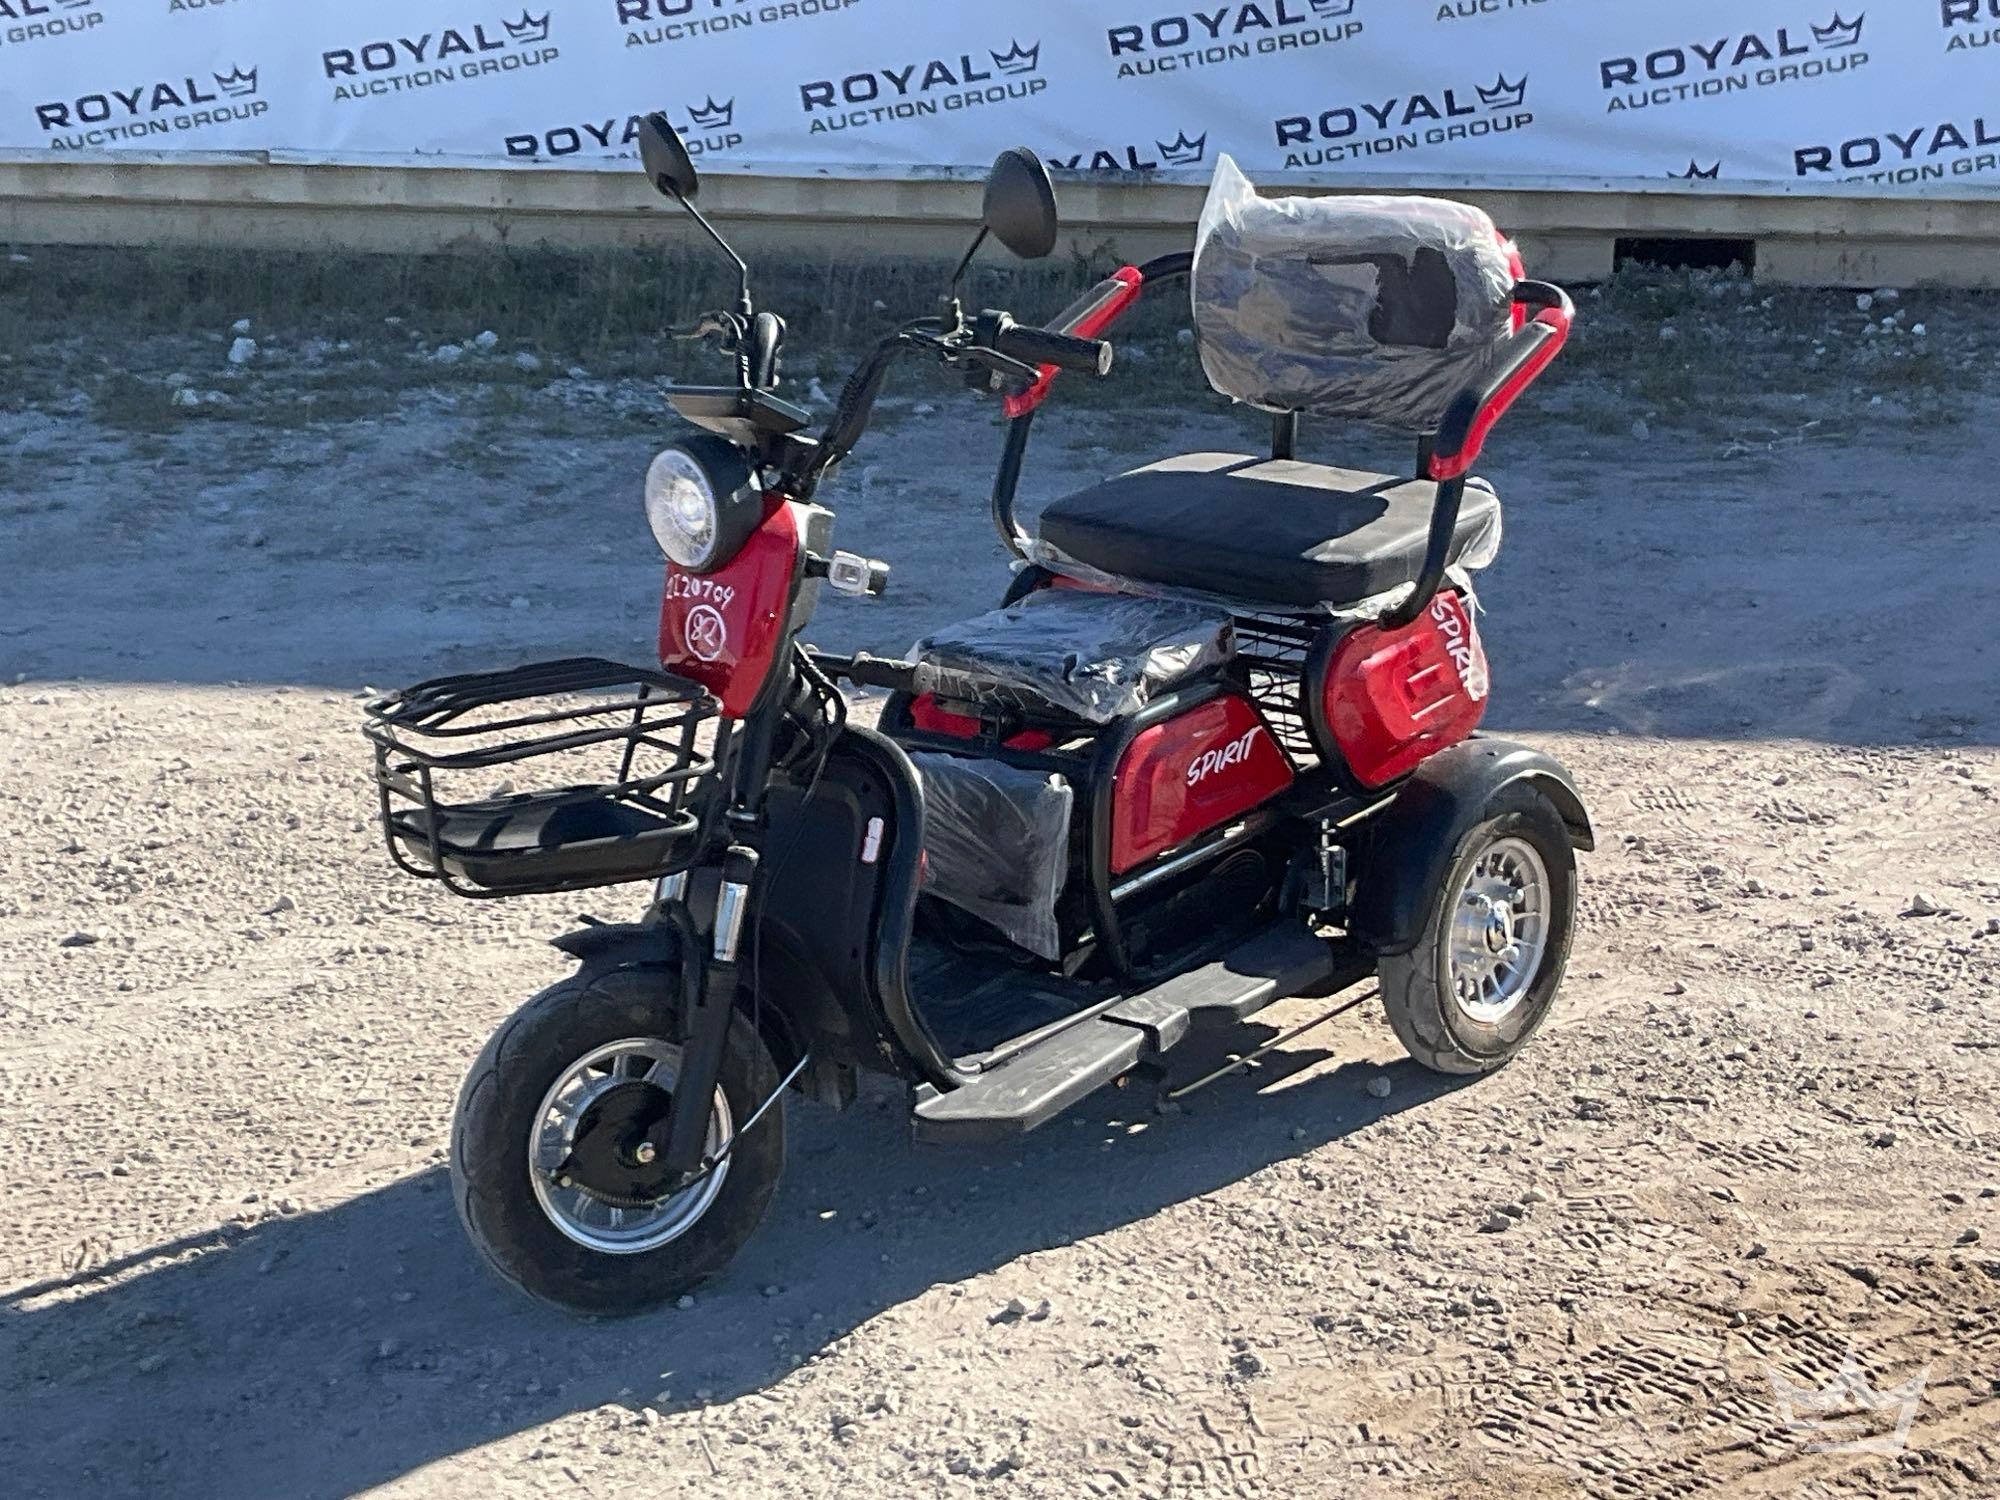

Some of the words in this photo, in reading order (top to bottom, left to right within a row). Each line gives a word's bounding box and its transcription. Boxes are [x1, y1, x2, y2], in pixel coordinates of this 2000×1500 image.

[8, 12, 103, 43] GROUP
[322, 24, 504, 78] ROYAL
[625, 12, 752, 48] AUCTION
[1108, 0, 1305, 56] ROYAL
[1117, 42, 1249, 79] AUCTION
[1257, 22, 1363, 54] GROUP
[333, 66, 454, 101] AUCTION
[461, 48, 559, 79] GROUP
[800, 55, 991, 111] ROYAL
[1600, 29, 1808, 89] ROYAL
[1607, 74, 1747, 113] AUCTION
[1756, 52, 1869, 86] GROUP
[35, 78, 216, 130] ROYAL
[50, 119, 168, 151] AUCTION
[174, 101, 269, 130] GROUP
[809, 98, 936, 134] AUCTION
[944, 78, 1047, 110] GROUP
[1275, 90, 1475, 146] ROYAL
[1284, 133, 1418, 169] AUCTION
[1425, 112, 1533, 145] GROUP
[1794, 118, 2000, 176] ROYAL
[1187, 725, 1263, 787] SPIRIT
